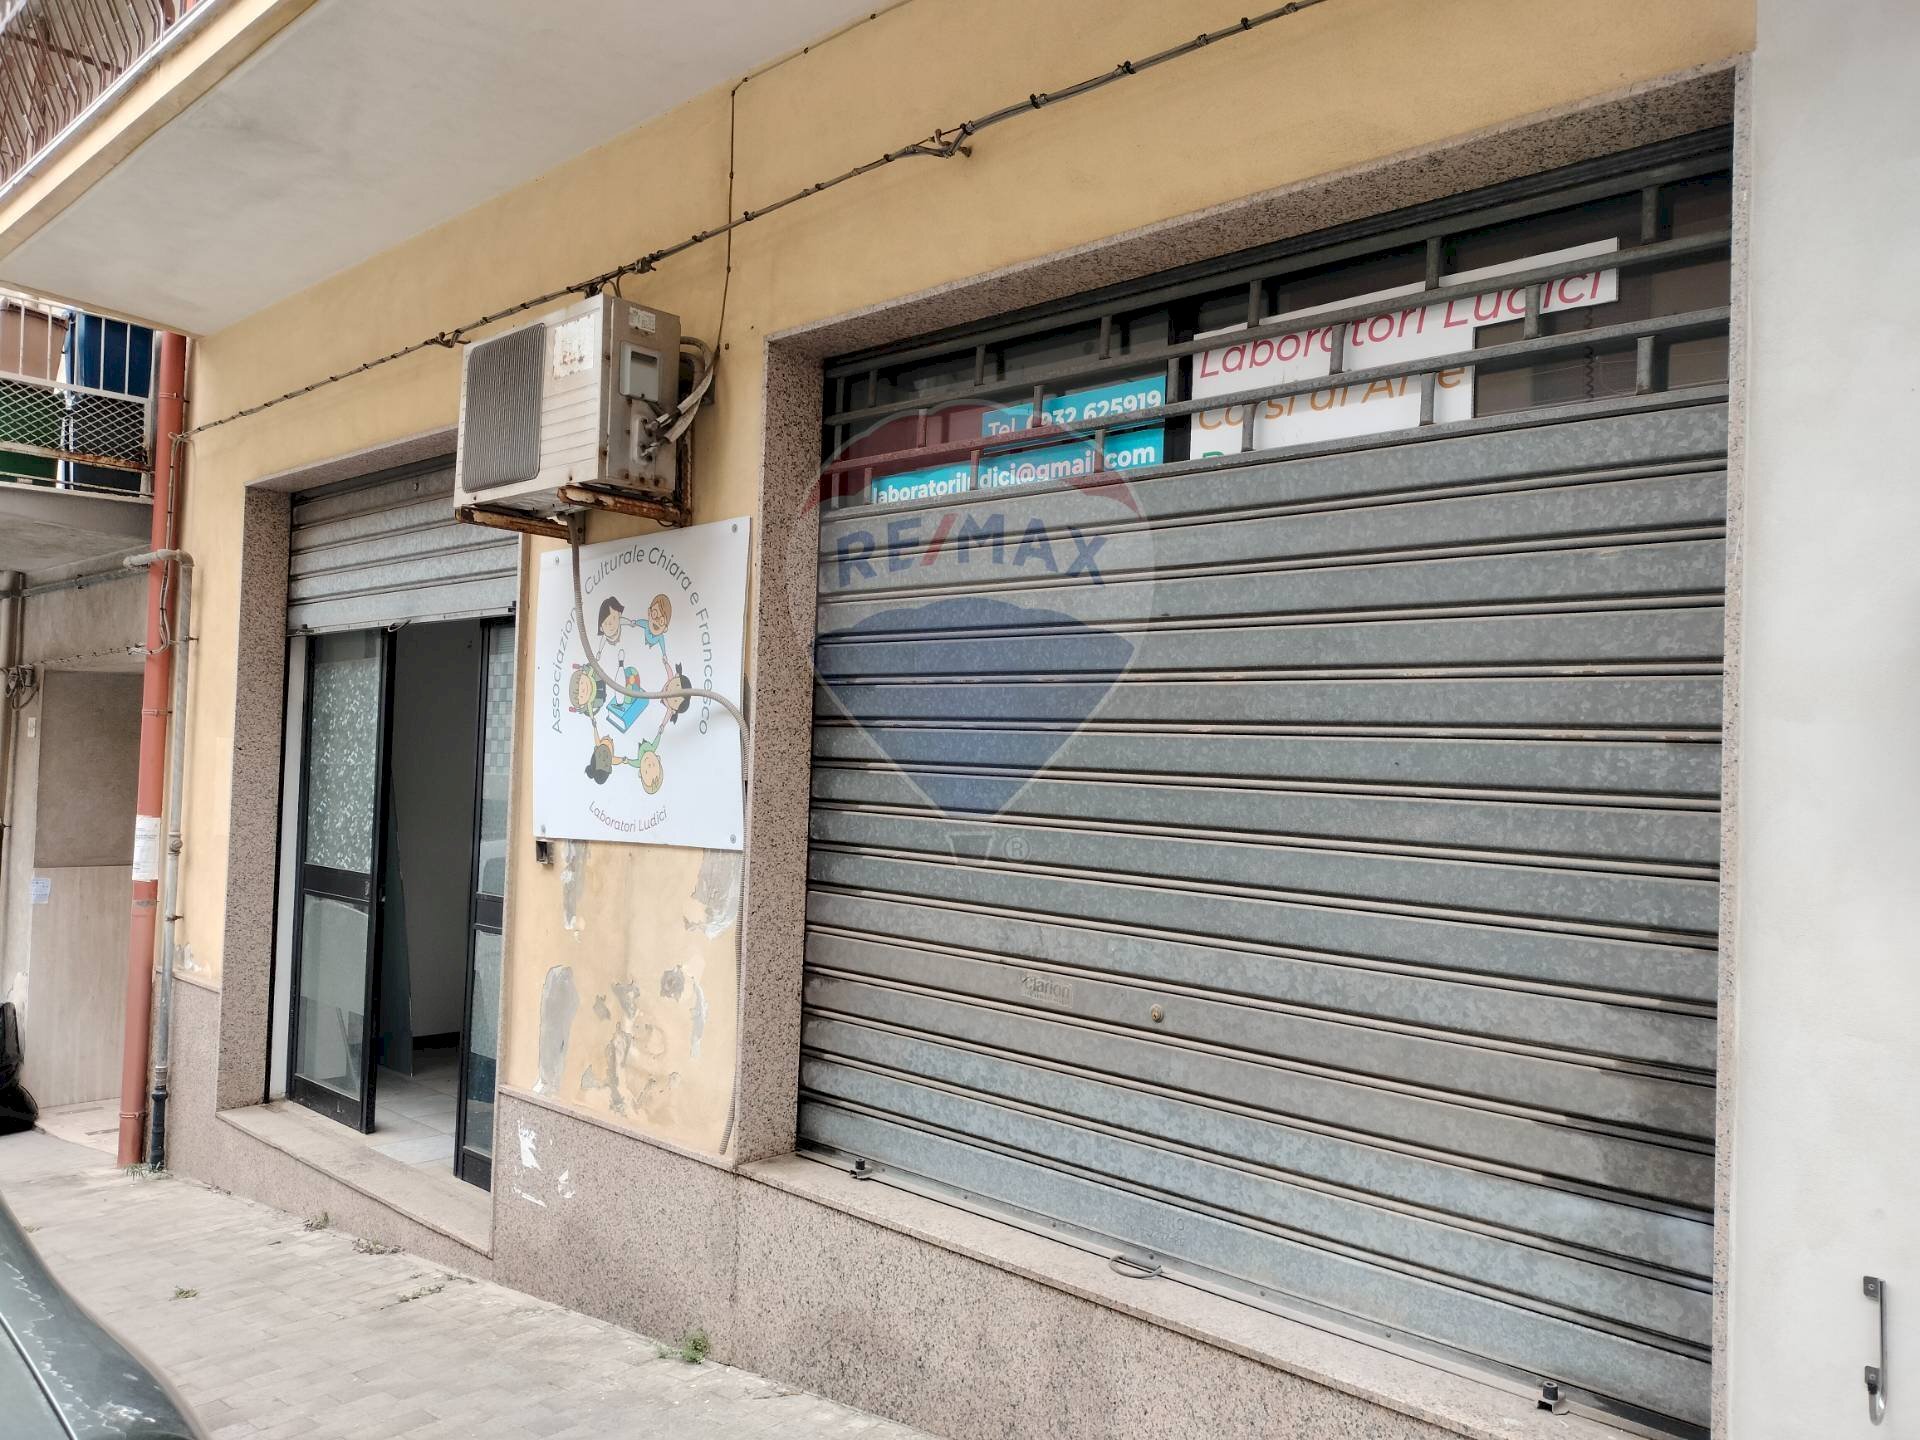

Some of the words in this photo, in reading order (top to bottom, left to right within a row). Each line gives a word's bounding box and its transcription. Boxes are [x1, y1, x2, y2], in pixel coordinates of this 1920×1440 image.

[1083, 390, 1162, 421] 625919
[872, 445, 1156, 505] laboratorildici@gmailcom
[552, 607, 578, 735] Associazion
[584, 544, 645, 594] Culturale
[648, 547, 693, 592] Chiara
[689, 591, 700, 606] e
[695, 606, 713, 735] Francesco
[588, 800, 636, 833] Laboratori
[638, 804, 668, 832] Ludici
